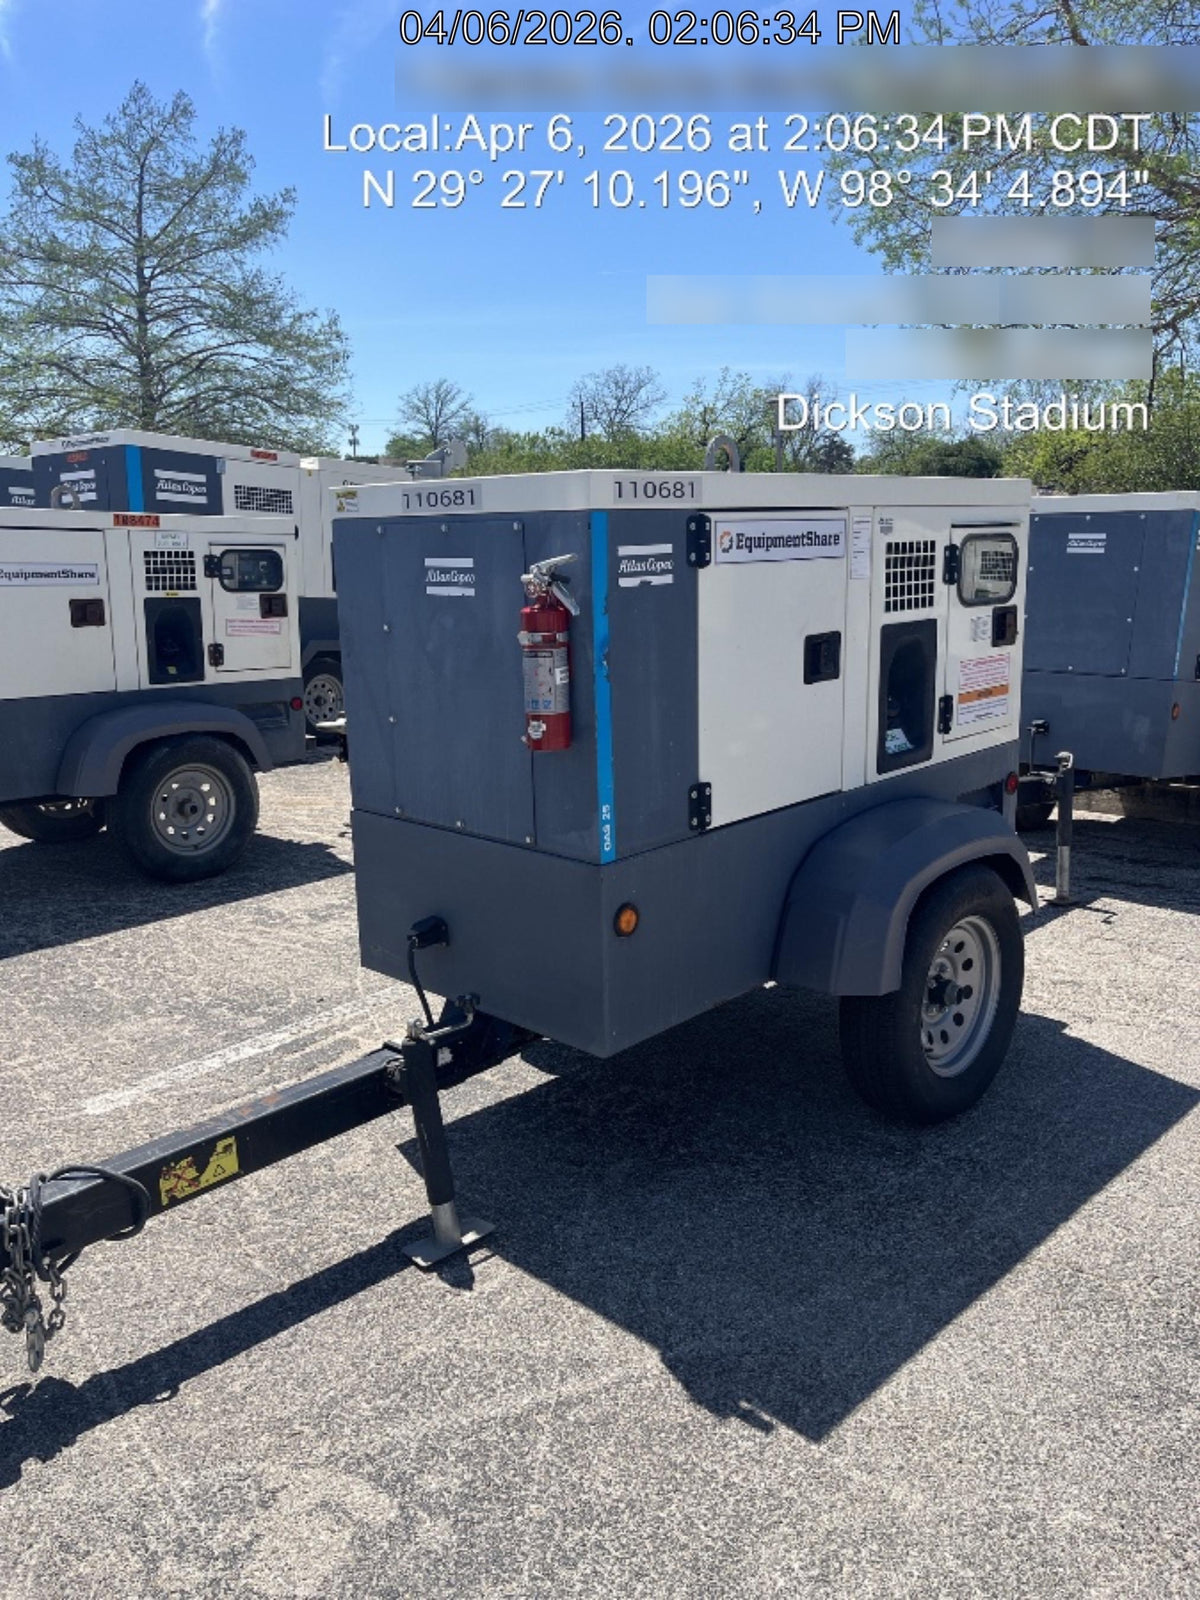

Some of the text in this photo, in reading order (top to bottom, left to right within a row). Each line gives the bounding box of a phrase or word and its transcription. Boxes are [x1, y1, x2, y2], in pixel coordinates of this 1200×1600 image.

[402, 488, 476, 510] 110681
[614, 480, 696, 499] 110681
[735, 531, 841, 553] EquipmentShare
